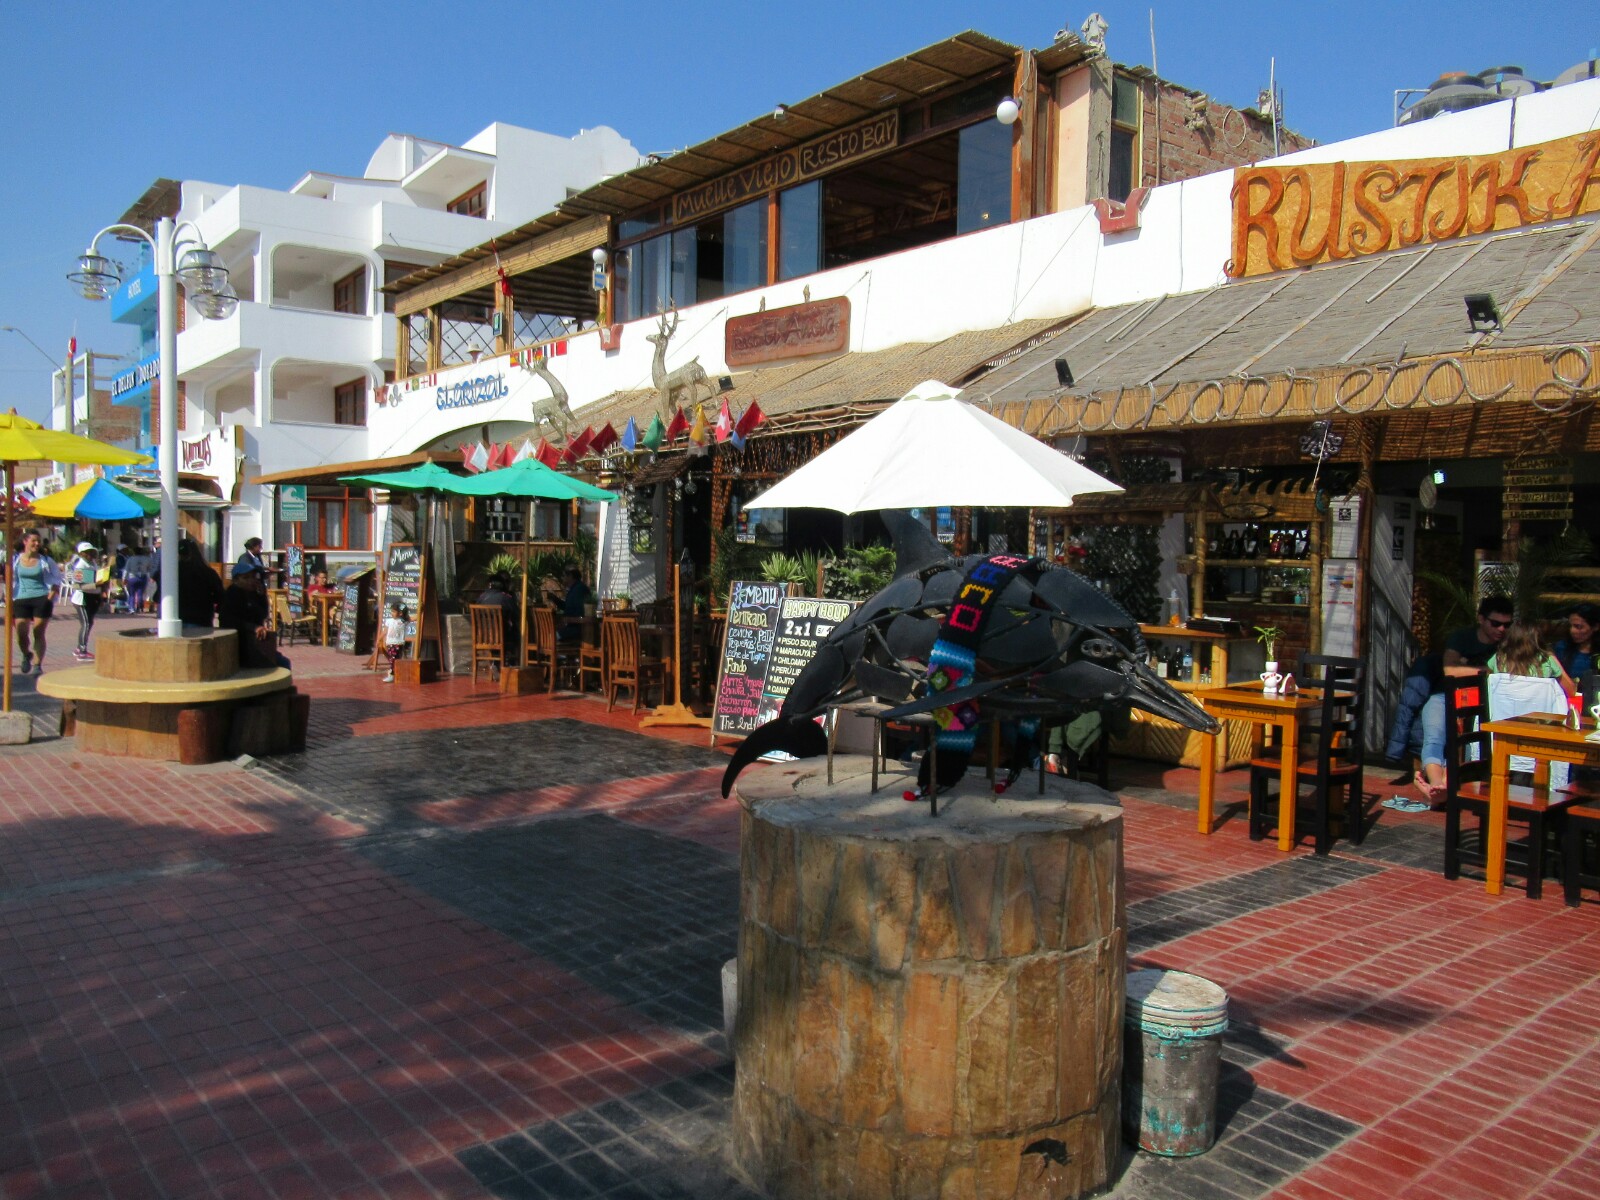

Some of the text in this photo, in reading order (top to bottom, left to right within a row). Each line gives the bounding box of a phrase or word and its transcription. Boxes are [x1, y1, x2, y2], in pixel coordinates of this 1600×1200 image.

[802, 132, 859, 170] Resto
[677, 156, 791, 218] Muelle Viejo
[391, 549, 413, 566] Menu
[745, 585, 777, 605] Menu
[782, 600, 850, 622] HAPPY HOUR
[781, 637, 817, 648] PISCO SOUR
[724, 657, 748, 673] Fondo
[775, 664, 791, 675] PERÚ
[777, 657, 807, 667] CHILCANO
[773, 676, 795, 686] MOJITO
[720, 715, 735, 731] The
